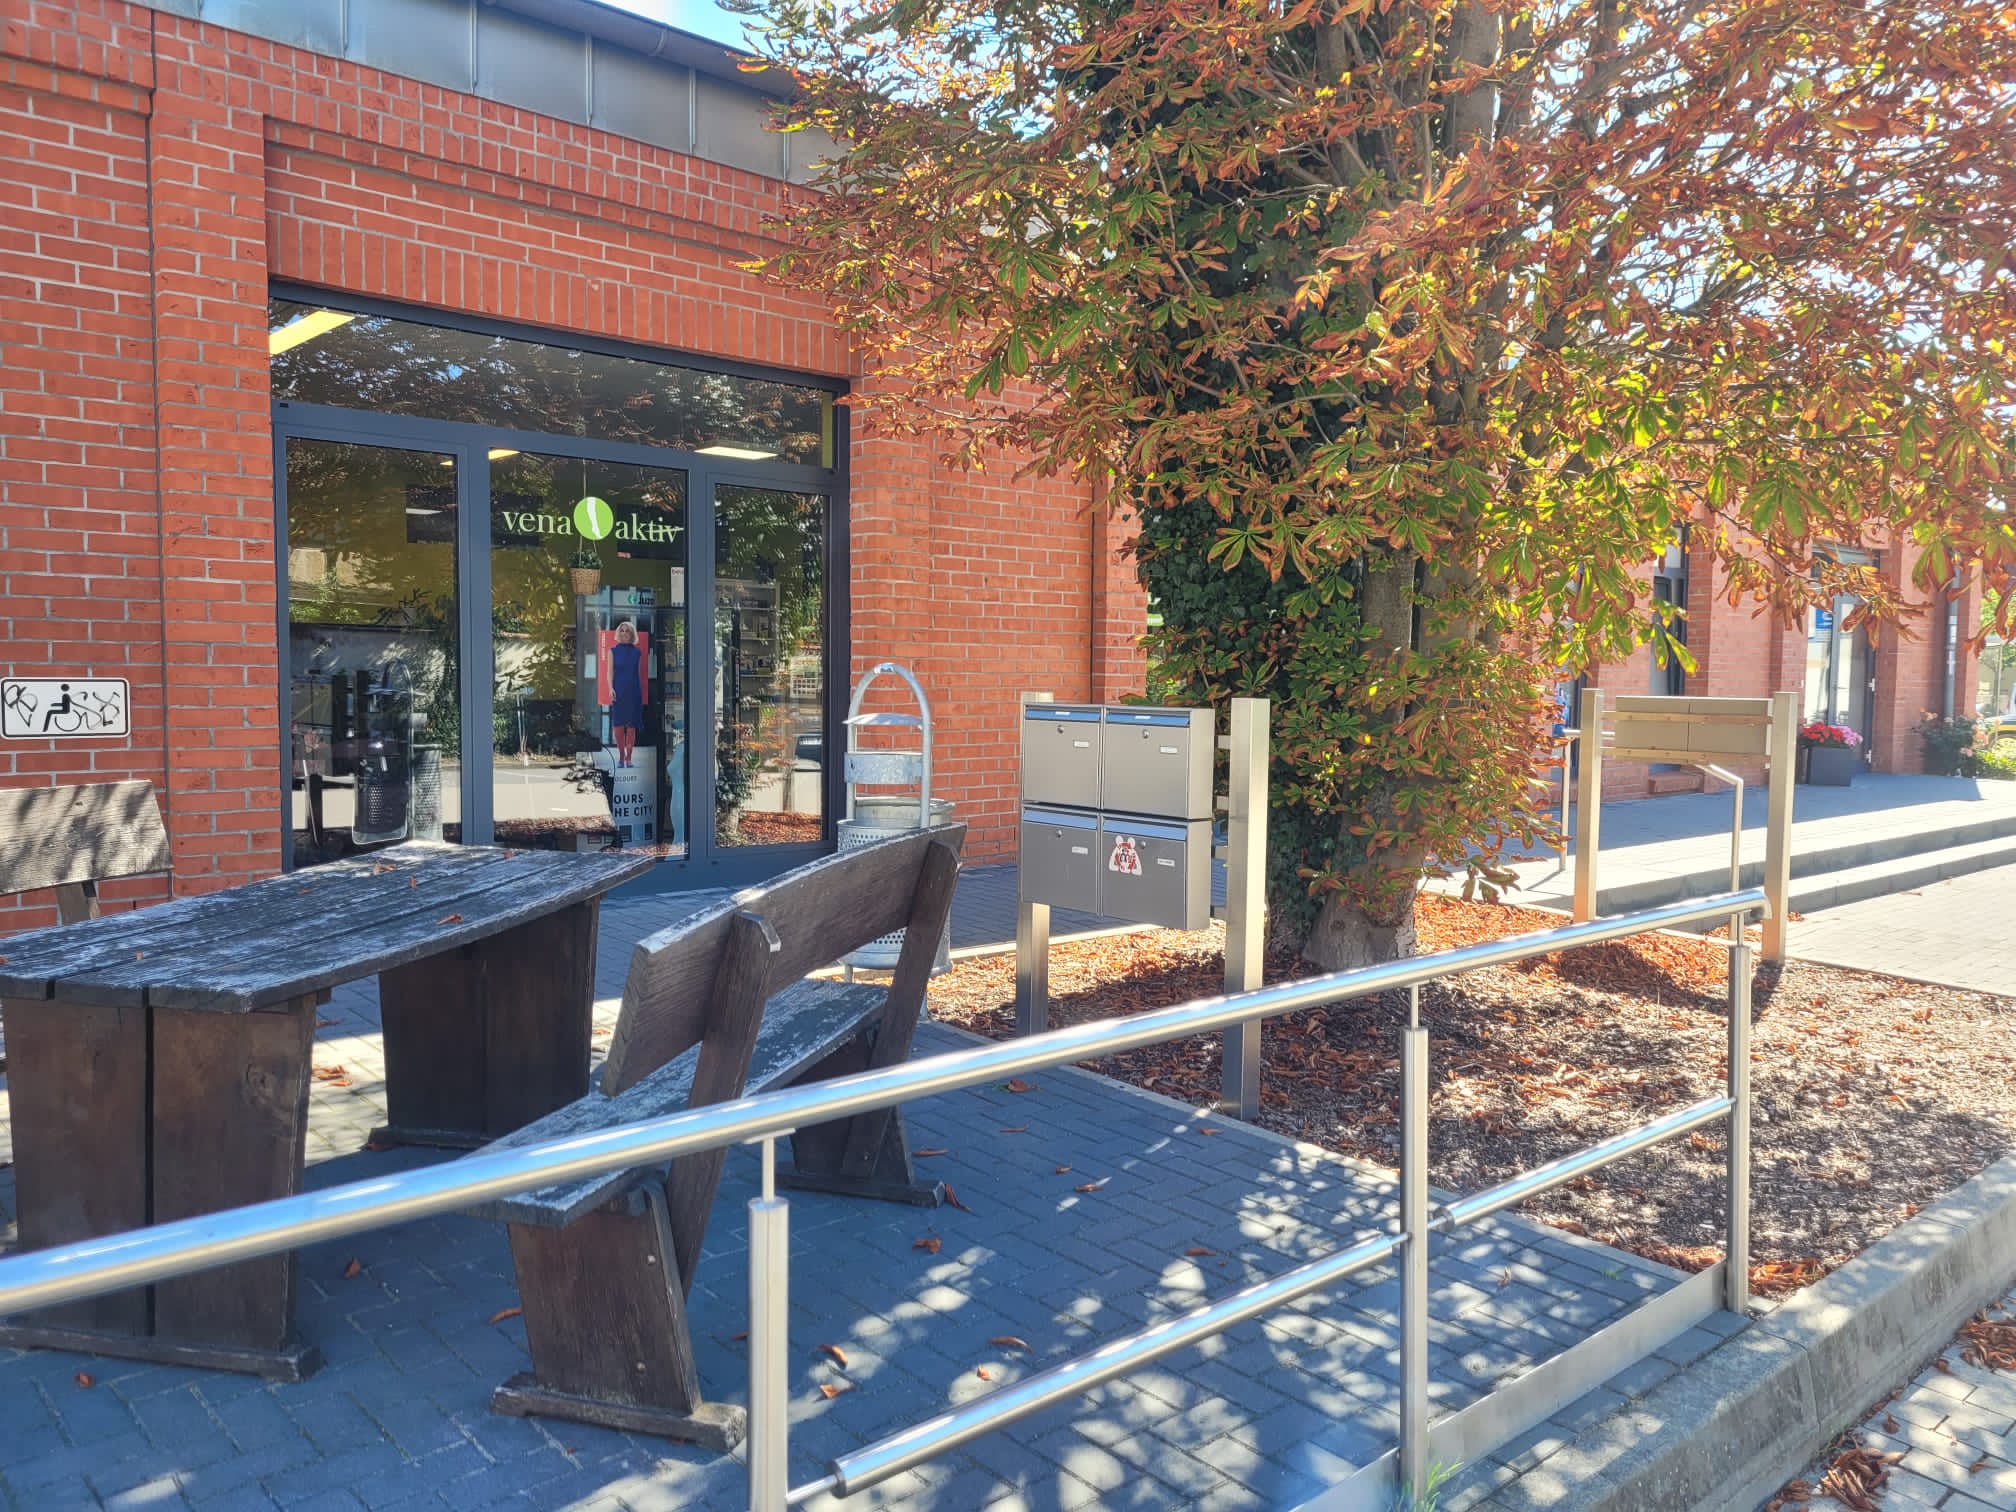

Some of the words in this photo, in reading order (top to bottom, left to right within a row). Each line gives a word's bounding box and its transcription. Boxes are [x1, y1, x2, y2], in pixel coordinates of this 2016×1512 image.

[502, 511, 574, 535] vena
[615, 513, 684, 543] aktiv
[614, 793, 644, 805] OURS
[614, 807, 630, 817] HE
[634, 805, 653, 817] CITY
